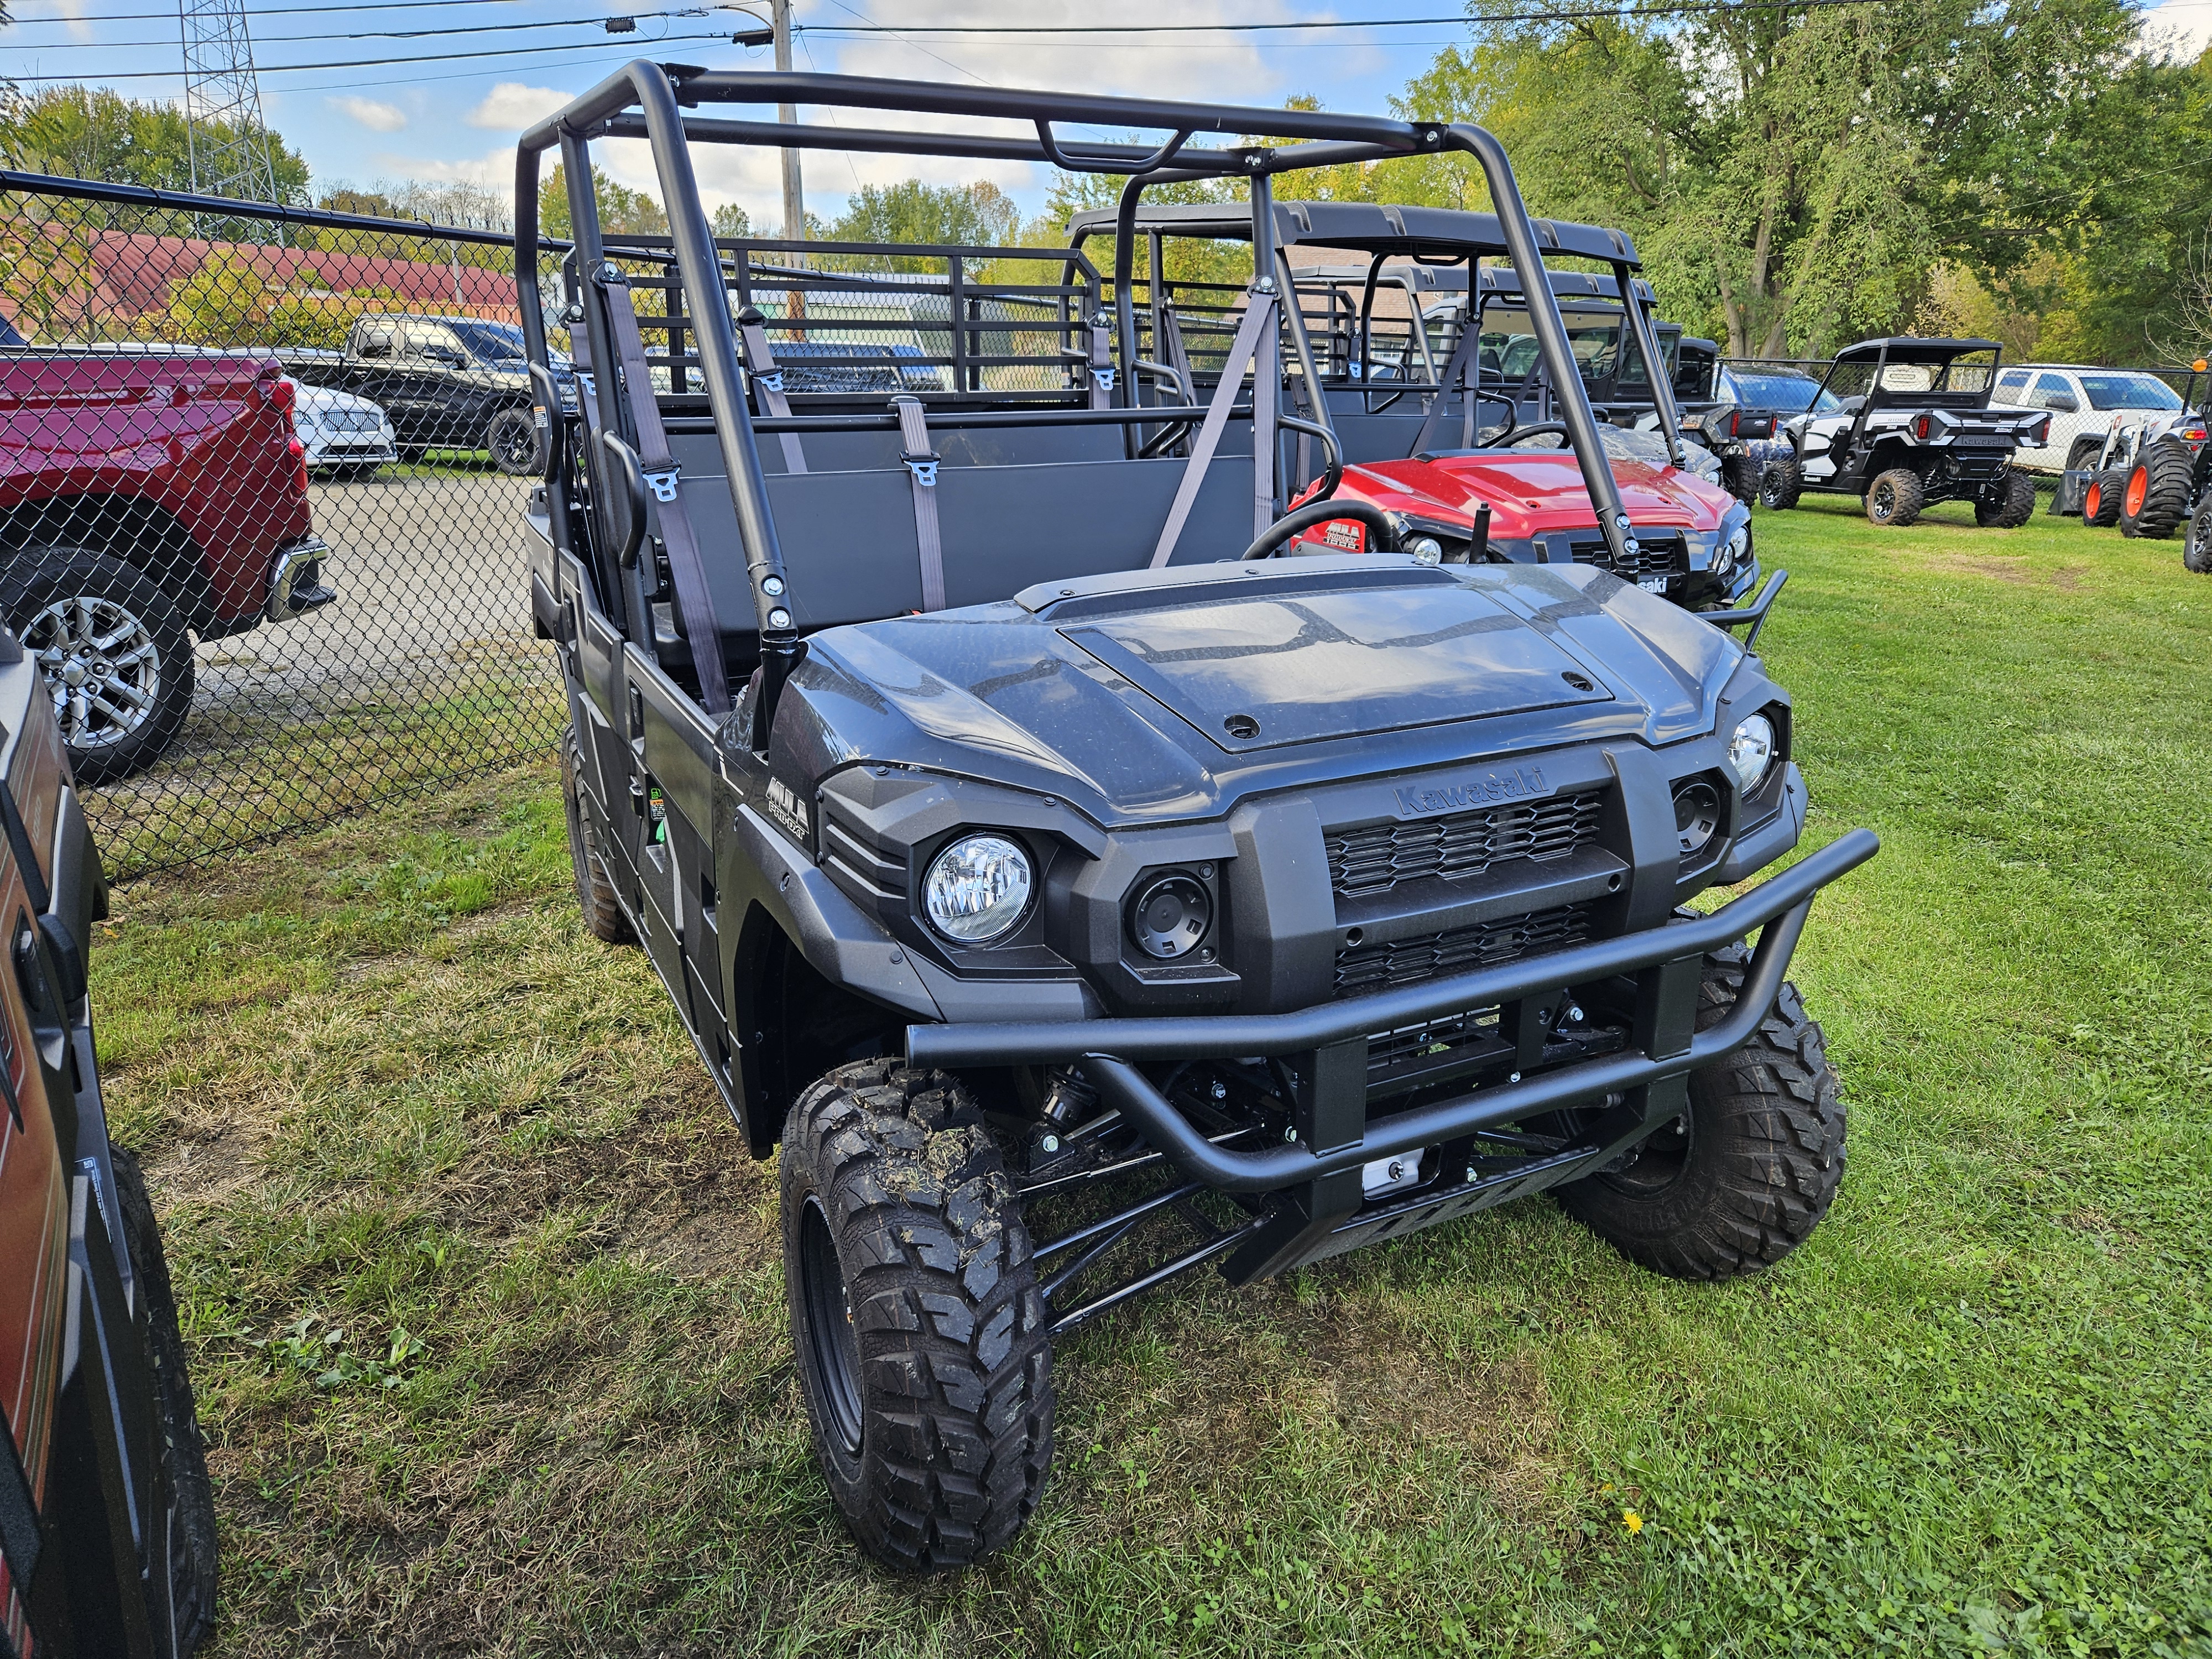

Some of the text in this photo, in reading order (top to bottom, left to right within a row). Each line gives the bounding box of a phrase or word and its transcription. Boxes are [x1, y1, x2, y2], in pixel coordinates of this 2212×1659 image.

[1961, 436, 2007, 446] Kawasaki
[765, 776, 810, 834] MULE
[1394, 766, 1550, 815] Kawasaki
